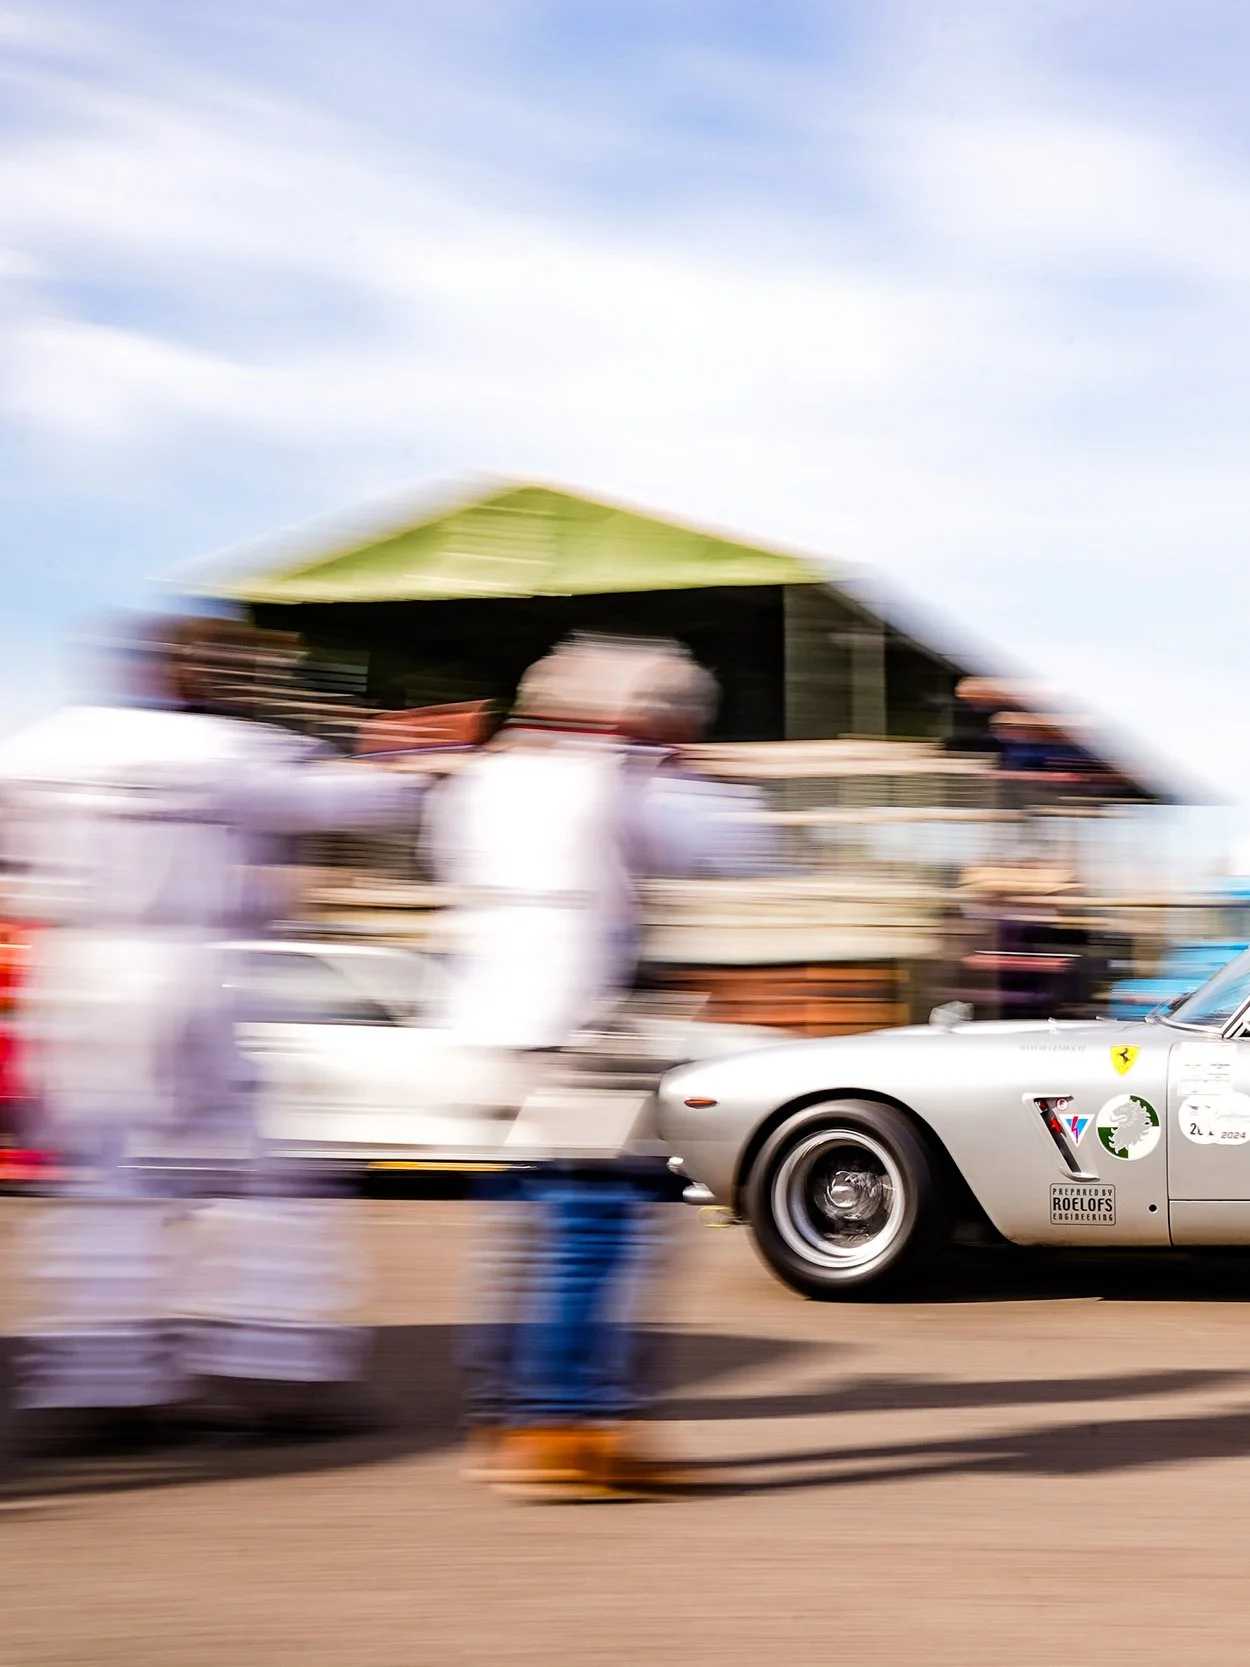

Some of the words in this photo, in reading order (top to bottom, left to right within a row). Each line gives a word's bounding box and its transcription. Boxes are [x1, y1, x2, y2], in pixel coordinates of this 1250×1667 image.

[1220, 1131, 1247, 1140] 2024
[1052, 1187, 1099, 1196] PREPARED
[1101, 1188, 1113, 1197] BY
[1052, 1197, 1113, 1212] ROELOFS
[1052, 1213, 1113, 1221] ENGINEERING
